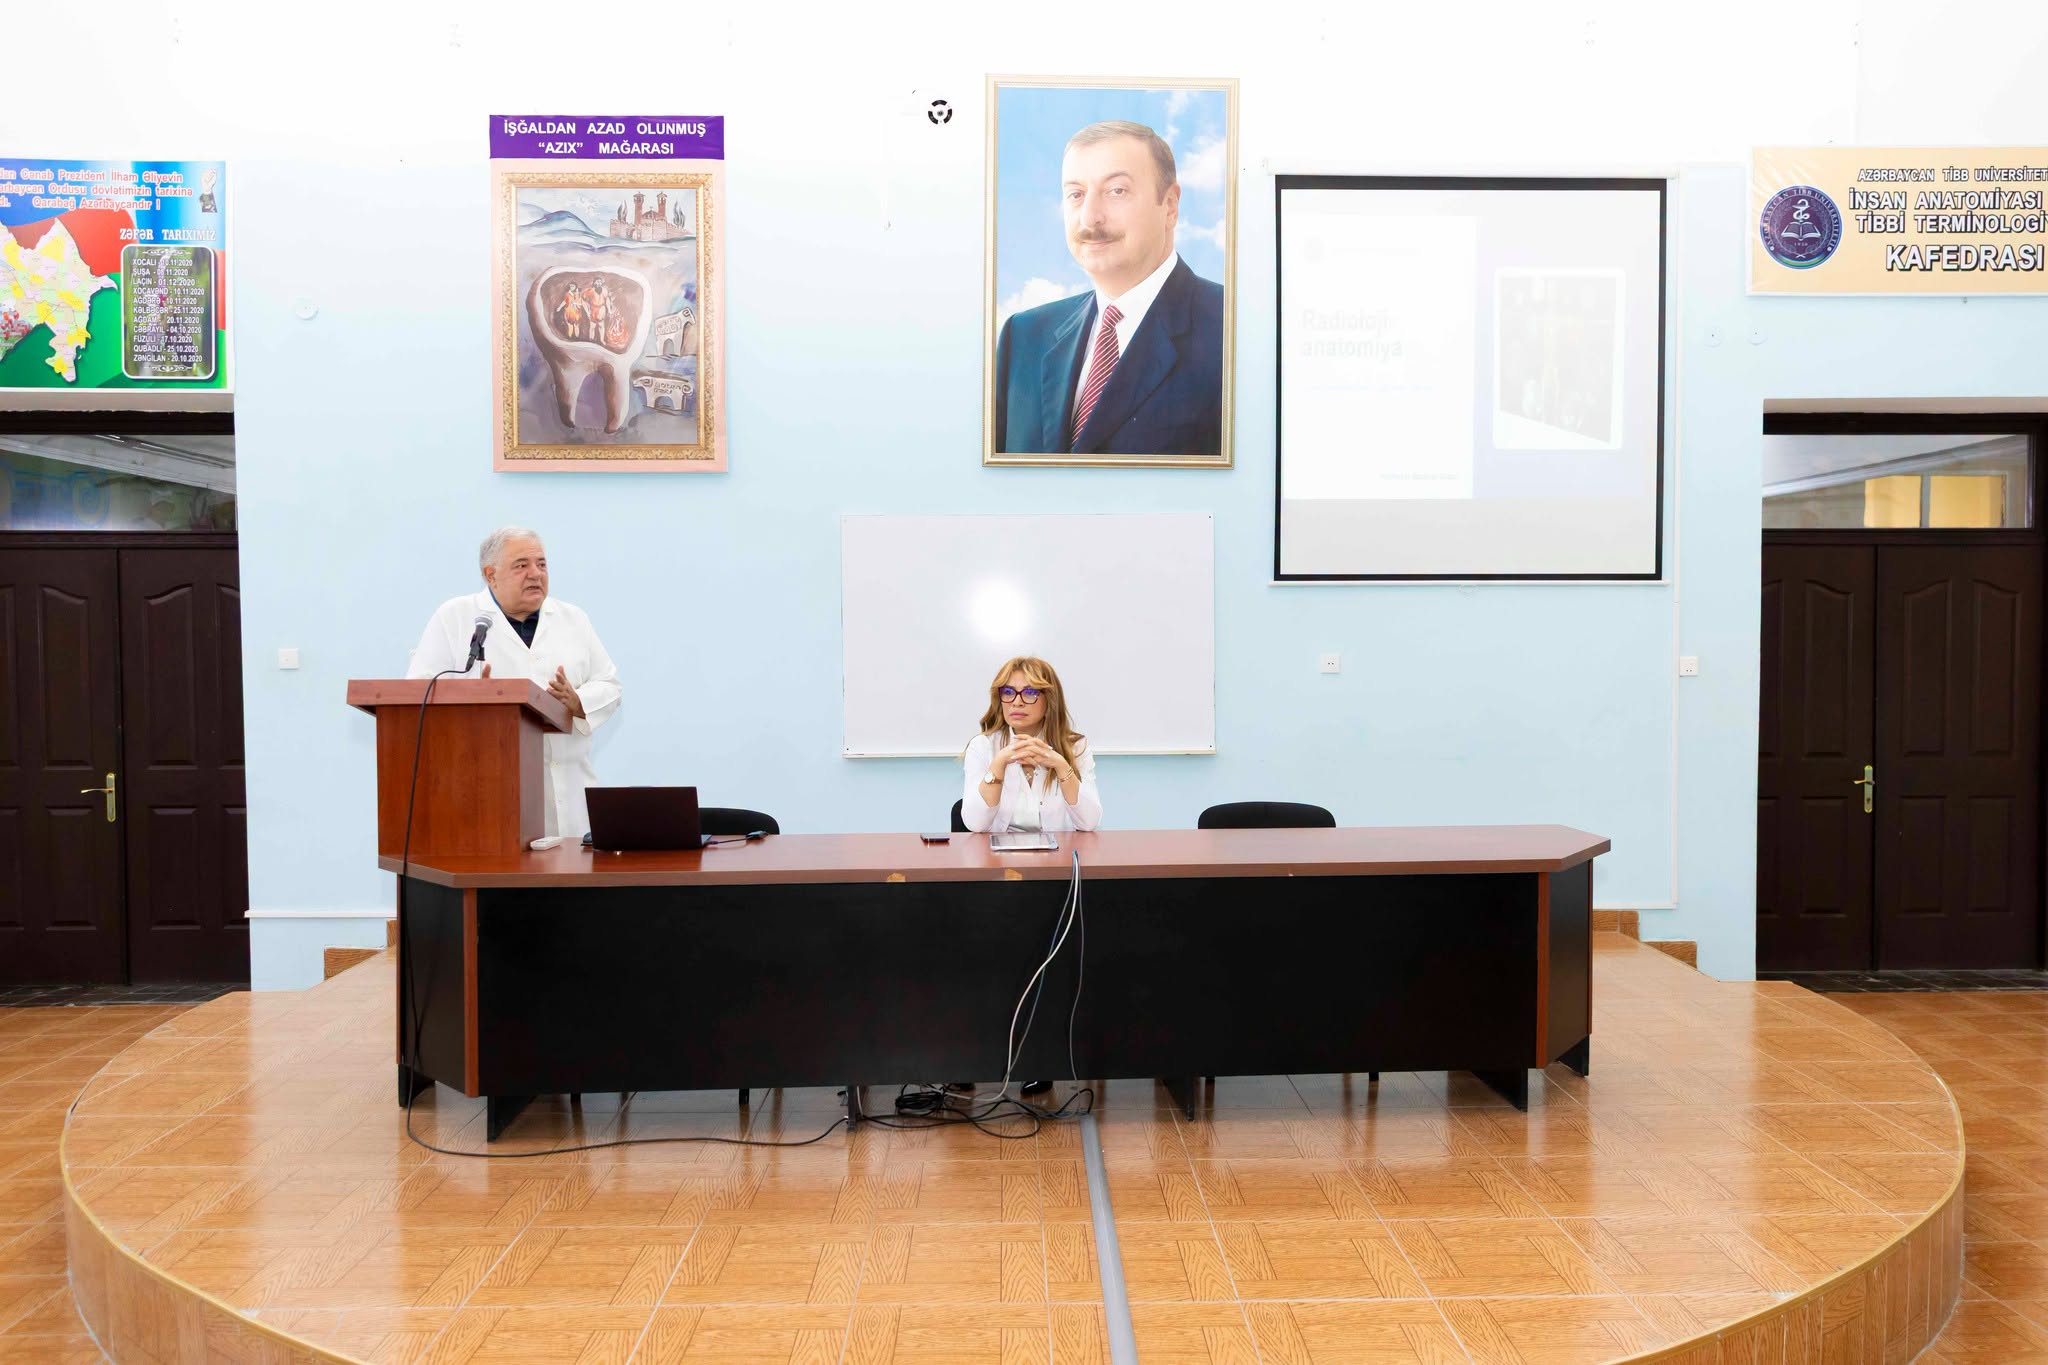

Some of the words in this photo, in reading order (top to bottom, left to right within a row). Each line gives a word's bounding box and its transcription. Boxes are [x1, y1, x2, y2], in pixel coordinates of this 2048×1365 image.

[504, 119, 576, 136] İŞĞALDAN
[587, 122, 625, 134] AZAD
[636, 122, 706, 137] OLUNMUŞ
[599, 140, 674, 154] MAĞARASI
[58, 169, 105, 181] Prezident
[143, 170, 183, 184] Əliyevin
[1857, 168, 1934, 181] AZƏRBAYCAN
[1942, 166, 1969, 181] TİBB
[49, 183, 86, 195] Ordusu
[91, 184, 151, 196] dövlətimizin
[155, 186, 193, 197] tarixinə
[1849, 187, 1906, 209] İNSAN
[1914, 187, 2042, 209] ANATOMİYASI
[32, 196, 76, 211] Qarabağ
[79, 197, 152, 212] Azərbaycandır
[1855, 210, 1905, 233] TİBBİ
[1914, 210, 2048, 233] TERMİNOLOGİ
[120, 228, 154, 240] ZƏFƏR
[1886, 244, 2044, 271] KAFEDRASI
[1302, 308, 1390, 336] Radioloji
[1302, 337, 1403, 363] anatomiya
